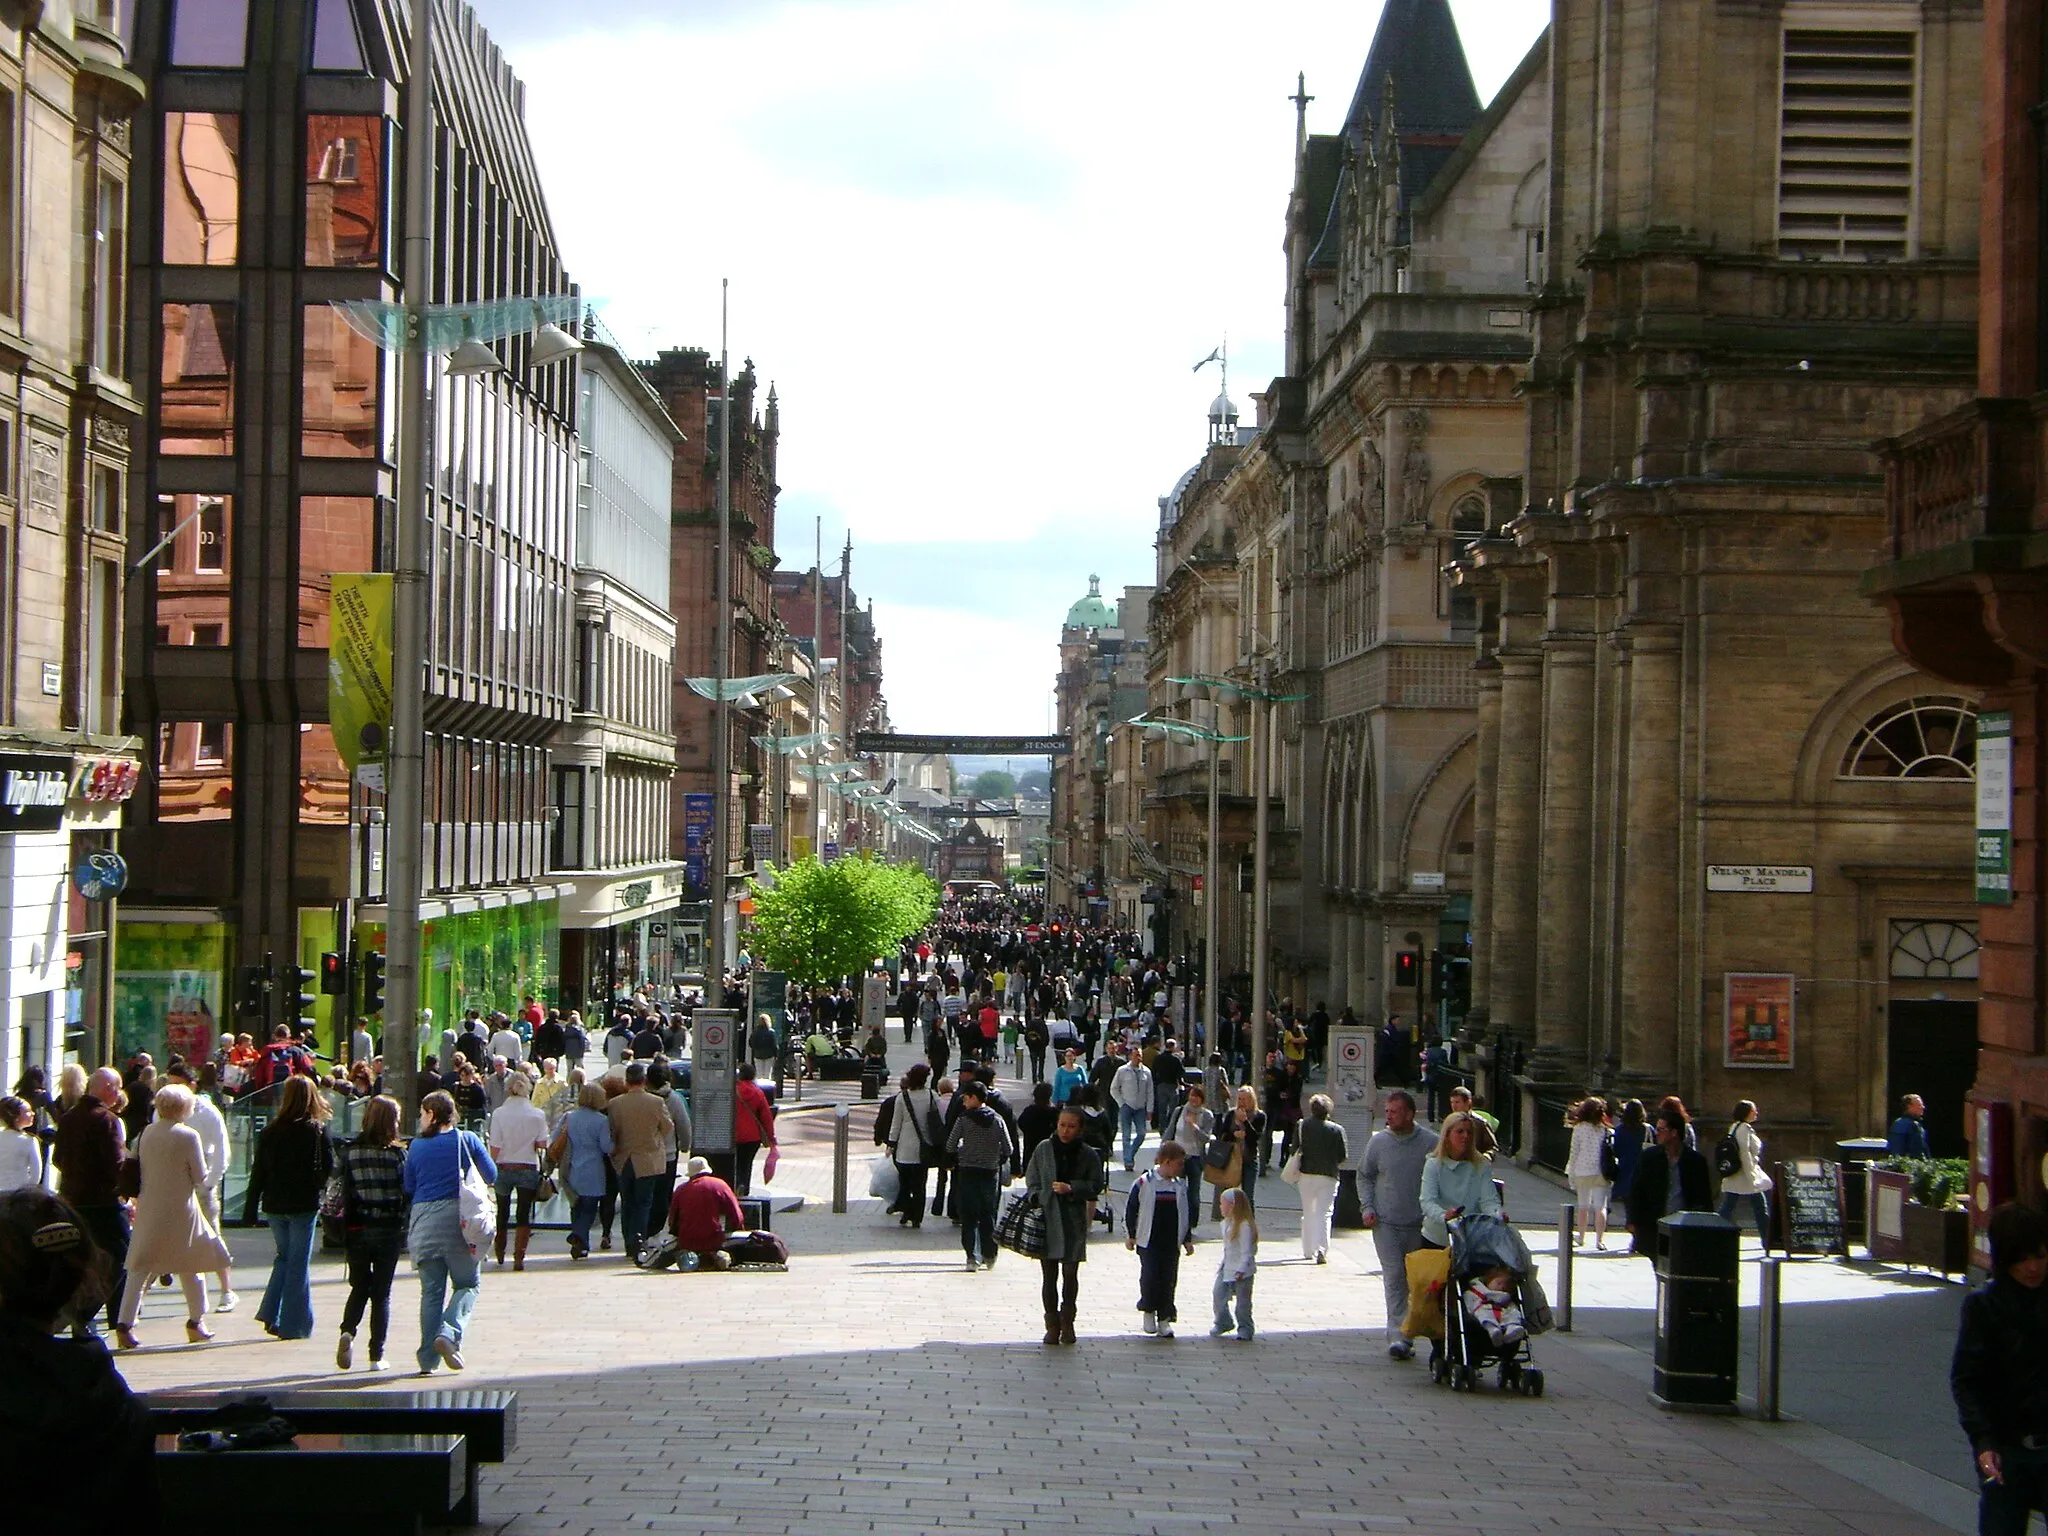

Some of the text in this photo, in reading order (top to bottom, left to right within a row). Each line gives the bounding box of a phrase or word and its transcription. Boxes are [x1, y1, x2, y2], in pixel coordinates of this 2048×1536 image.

[350, 584, 362, 600] THE
[341, 588, 374, 652] COMMONWEALTH
[334, 592, 347, 617] TABLE
[344, 617, 361, 643] TENNIS
[357, 642, 390, 705] CHAMPIONSHIPS
[1035, 741, 1066, 750] ENOCH
[1712, 867, 1808, 877] NELSON MANDELA
[1743, 877, 1776, 885] PLACE
